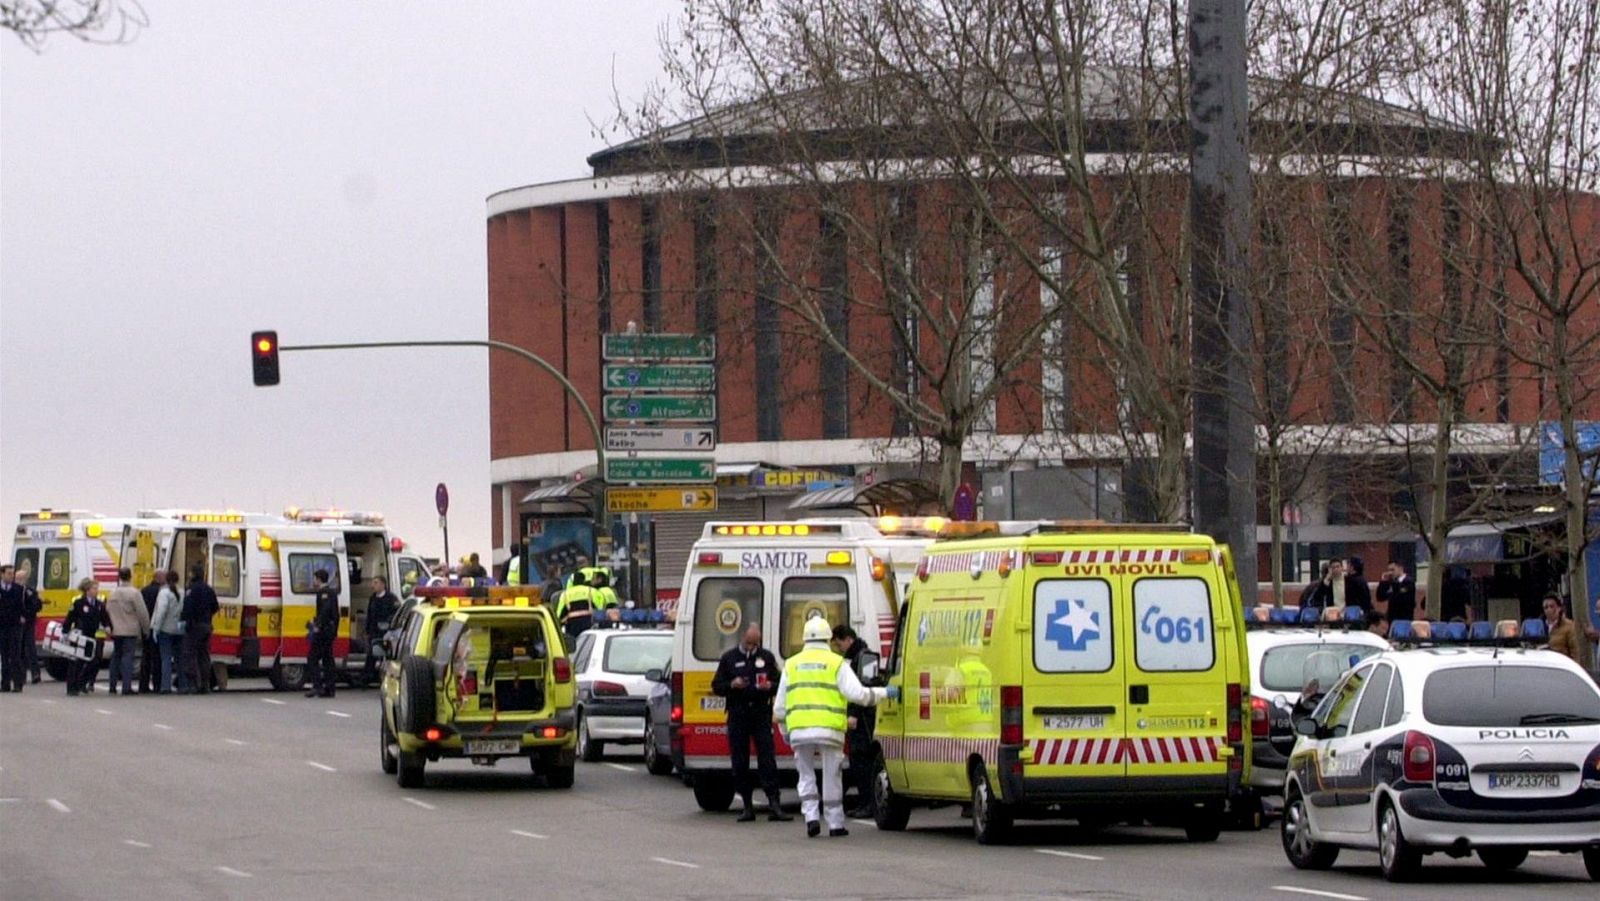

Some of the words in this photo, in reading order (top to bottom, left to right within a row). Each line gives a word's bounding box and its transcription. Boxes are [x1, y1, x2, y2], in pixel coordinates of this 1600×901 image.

[651, 470, 692, 478] Barcelona
[610, 500, 649, 509] Atocha
[741, 551, 808, 569] SAMUR
[1065, 565, 1101, 575] UVI
[1109, 564, 1178, 574] MOVIL
[1155, 616, 1204, 643] 061
[1187, 717, 1205, 728] 112
[1479, 729, 1569, 739] POLICIA
[1446, 763, 1467, 777] 091
